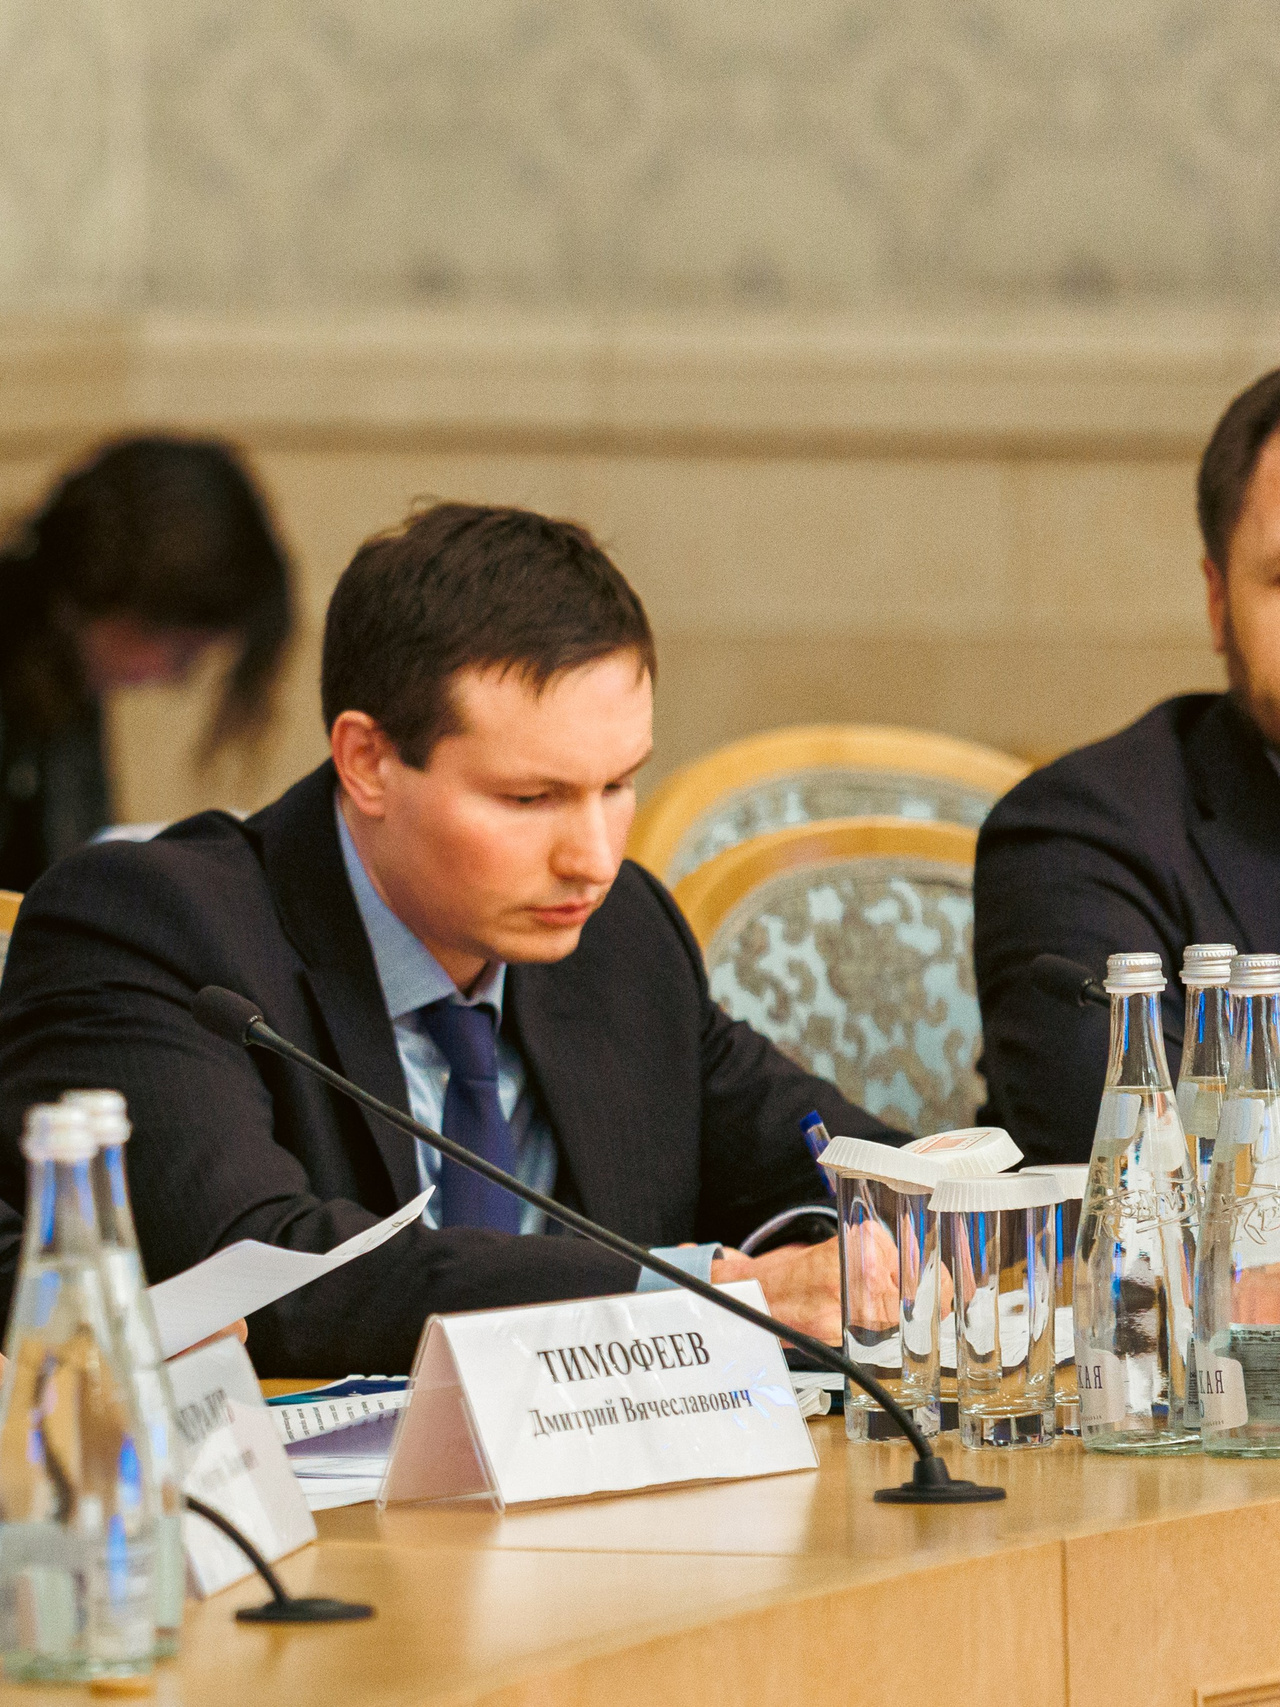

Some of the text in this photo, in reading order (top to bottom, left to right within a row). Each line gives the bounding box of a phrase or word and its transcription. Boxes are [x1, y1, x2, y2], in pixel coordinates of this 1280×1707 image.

[537, 1331, 711, 1384] ТИМОФЕЕВ
[528, 1389, 753, 1439] Дмитрий Вячеславович
